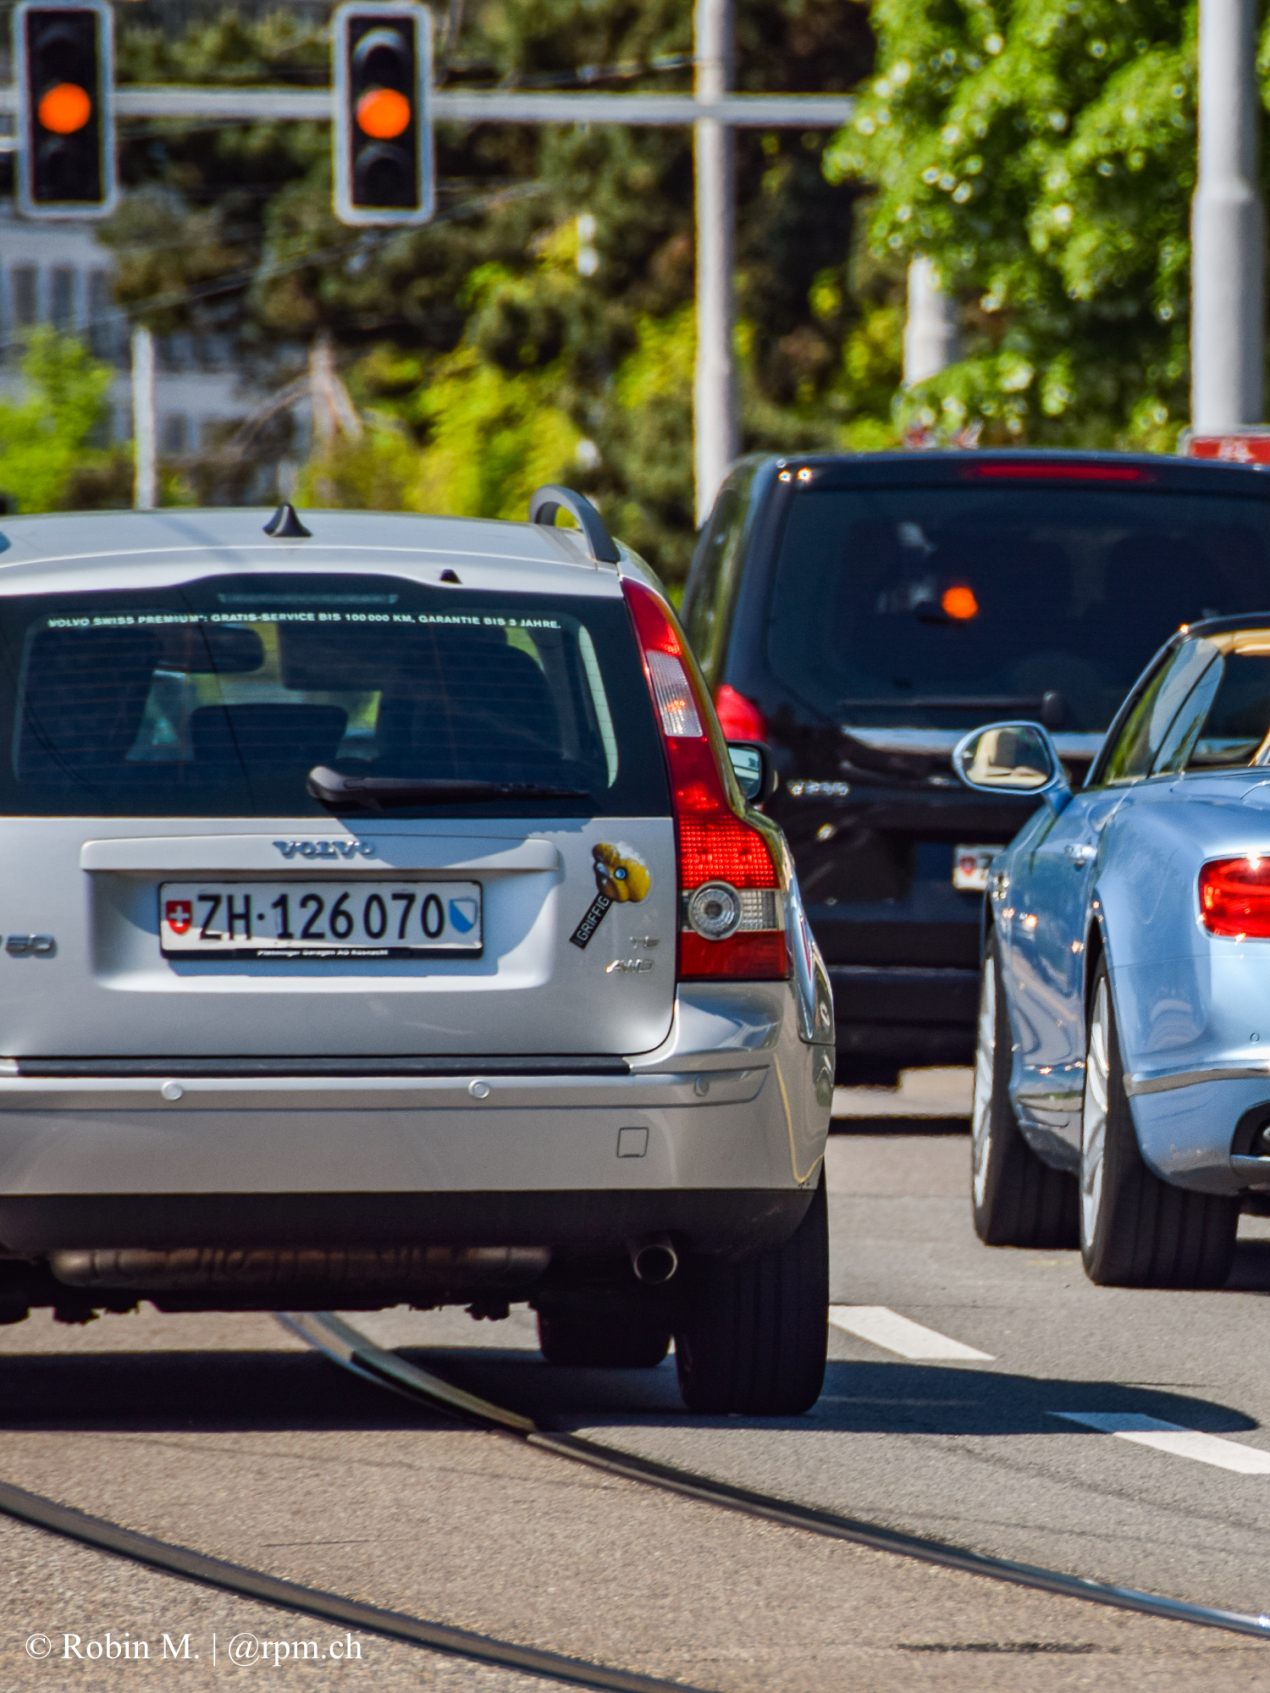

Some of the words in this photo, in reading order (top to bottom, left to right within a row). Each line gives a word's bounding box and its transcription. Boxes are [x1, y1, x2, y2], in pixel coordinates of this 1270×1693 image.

[48, 617, 90, 628] VOLVO
[93, 616, 134, 626] SWISS
[211, 612, 315, 622] GRATIS-SERVICE
[318, 612, 341, 621] BIS
[418, 615, 480, 625] GARANTIE
[484, 616, 505, 626] BIS
[509, 618, 517, 627] 3
[520, 618, 561, 629] JAHRE.
[272, 839, 376, 859] VOLVO
[576, 895, 611, 942] GRIFFIG
[0, 934, 57, 957] 50
[605, 958, 656, 974] AWD
